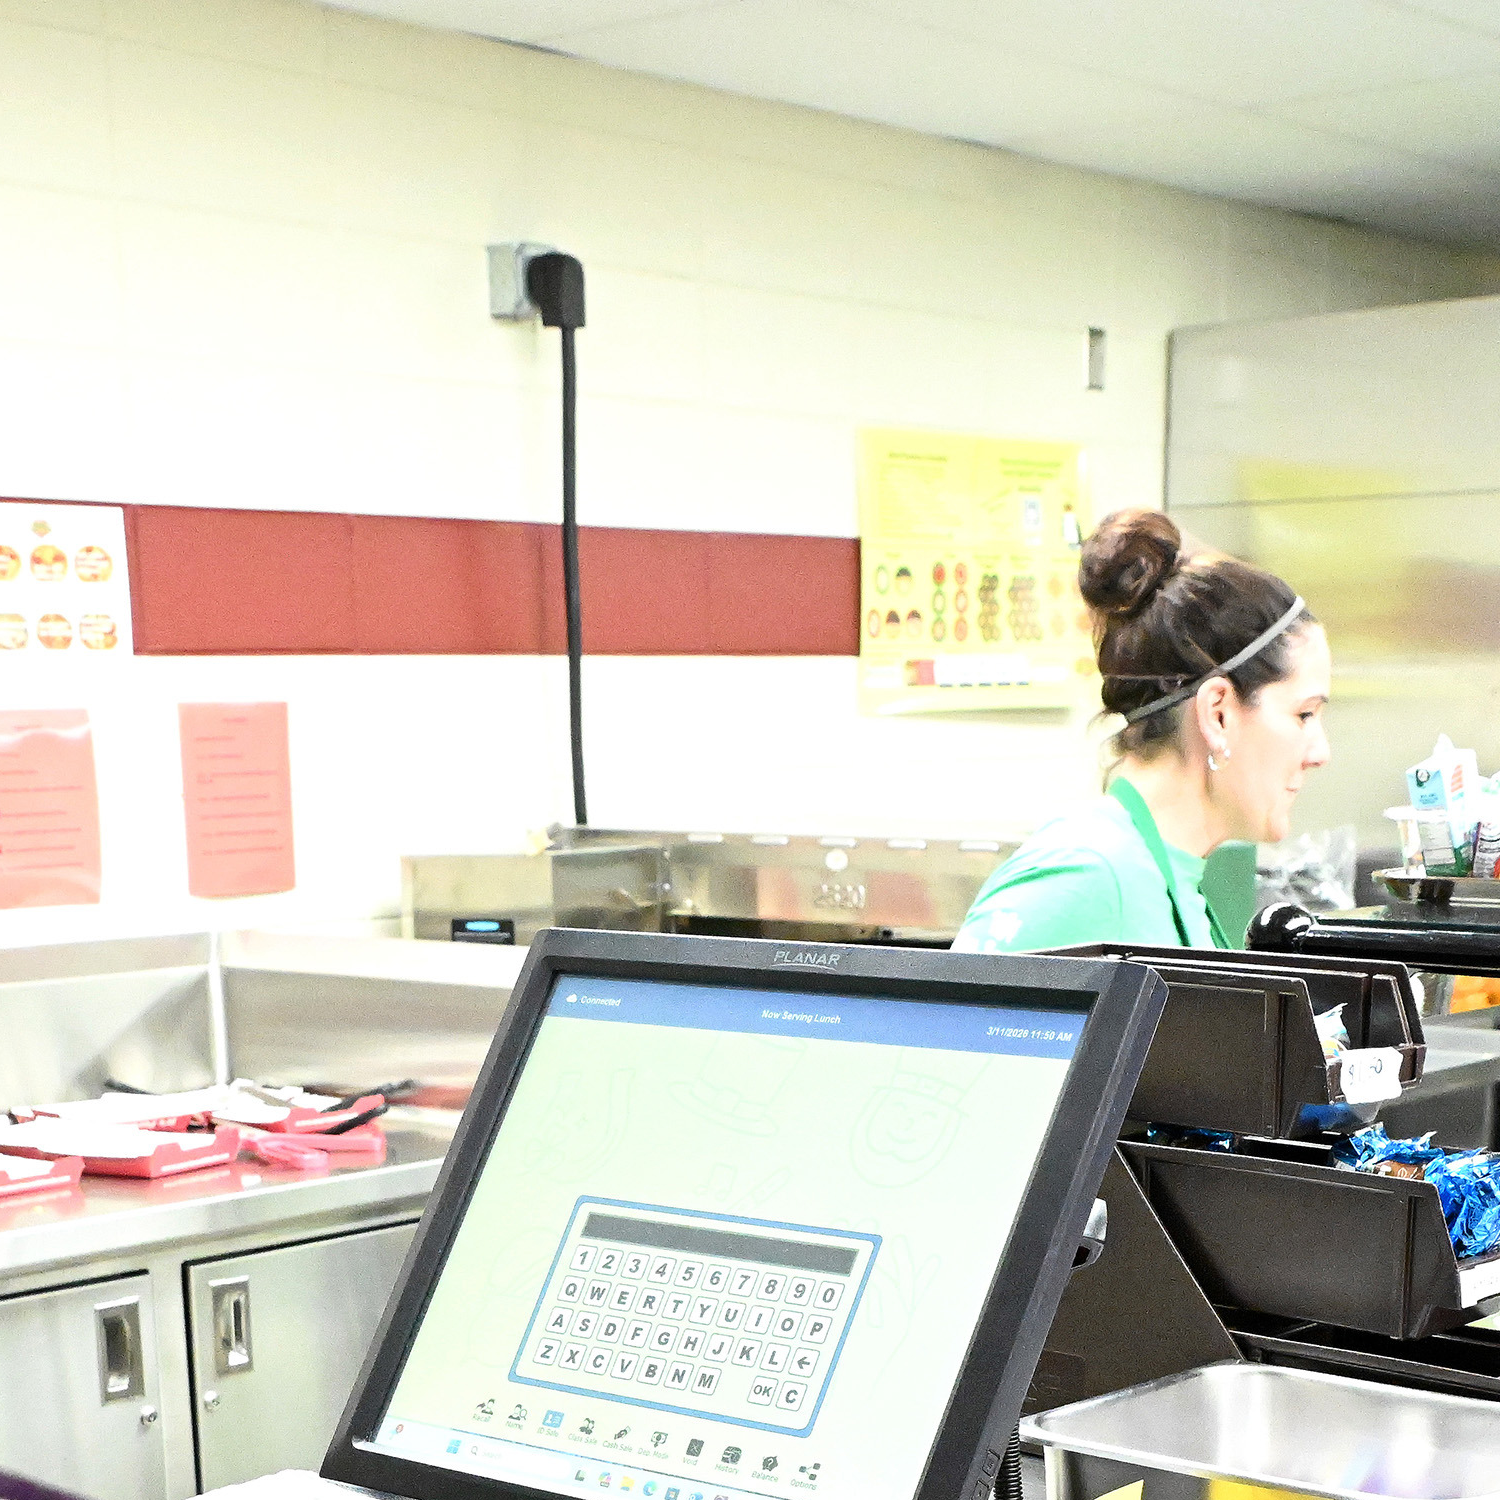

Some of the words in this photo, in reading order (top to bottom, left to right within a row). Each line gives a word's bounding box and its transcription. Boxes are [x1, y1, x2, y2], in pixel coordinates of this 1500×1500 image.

[773, 951, 841, 966] PLANAR
[580, 995, 622, 1007] Connected
[761, 1009, 780, 1020] Now
[781, 1010, 813, 1025] Serving
[814, 1013, 842, 1025] Lunch
[986, 1026, 1028, 1039] 3/11/2026
[1030, 1029, 1055, 1041] 11:50
[1056, 1031, 1073, 1042] AM
[580, 1252, 588, 1264] 1
[602, 1255, 614, 1269] 2
[629, 1259, 640, 1272] 3
[656, 1264, 667, 1277] 4
[682, 1267, 695, 1280] 5
[710, 1271, 722, 1285] 6
[738, 1275, 750, 1289] 7
[765, 1280, 777, 1294] 8
[794, 1284, 806, 1298] 9
[823, 1288, 834, 1302] 0
[566, 1283, 576, 1296] Q
[590, 1286, 606, 1300] W
[618, 1291, 629, 1304] E
[643, 1296, 655, 1309] R
[673, 1300, 683, 1313] T
[700, 1304, 710, 1317] Y
[725, 1308, 738, 1322] U
[755, 1314, 762, 1326] I
[781, 1318, 793, 1331] O
[810, 1322, 823, 1336] P
[552, 1314, 563, 1327] A
[579, 1319, 590, 1331] S
[604, 1323, 616, 1336] D
[631, 1327, 643, 1340] F
[658, 1332, 670, 1345] G
[684, 1336, 698, 1350] H
[712, 1342, 724, 1354] J
[739, 1346, 754, 1360] K
[769, 1351, 778, 1365] L
[541, 1345, 553, 1358] Z
[566, 1350, 579, 1363] X
[593, 1355, 604, 1368] C
[621, 1359, 632, 1372] V
[645, 1364, 657, 1377] B
[672, 1369, 686, 1383] N
[698, 1374, 714, 1388] M
[754, 1385, 772, 1397] OK
[786, 1390, 798, 1403] C
[505, 1420, 524, 1431] Name
[602, 1439, 616, 1449] Cash
[617, 1442, 633, 1453] Sale
[652, 1449, 670, 1461] Mode
[682, 1456, 698, 1467] Void
[714, 1463, 740, 1476] History
[751, 1471, 779, 1484] Balance
[790, 1478, 817, 1492] Options
